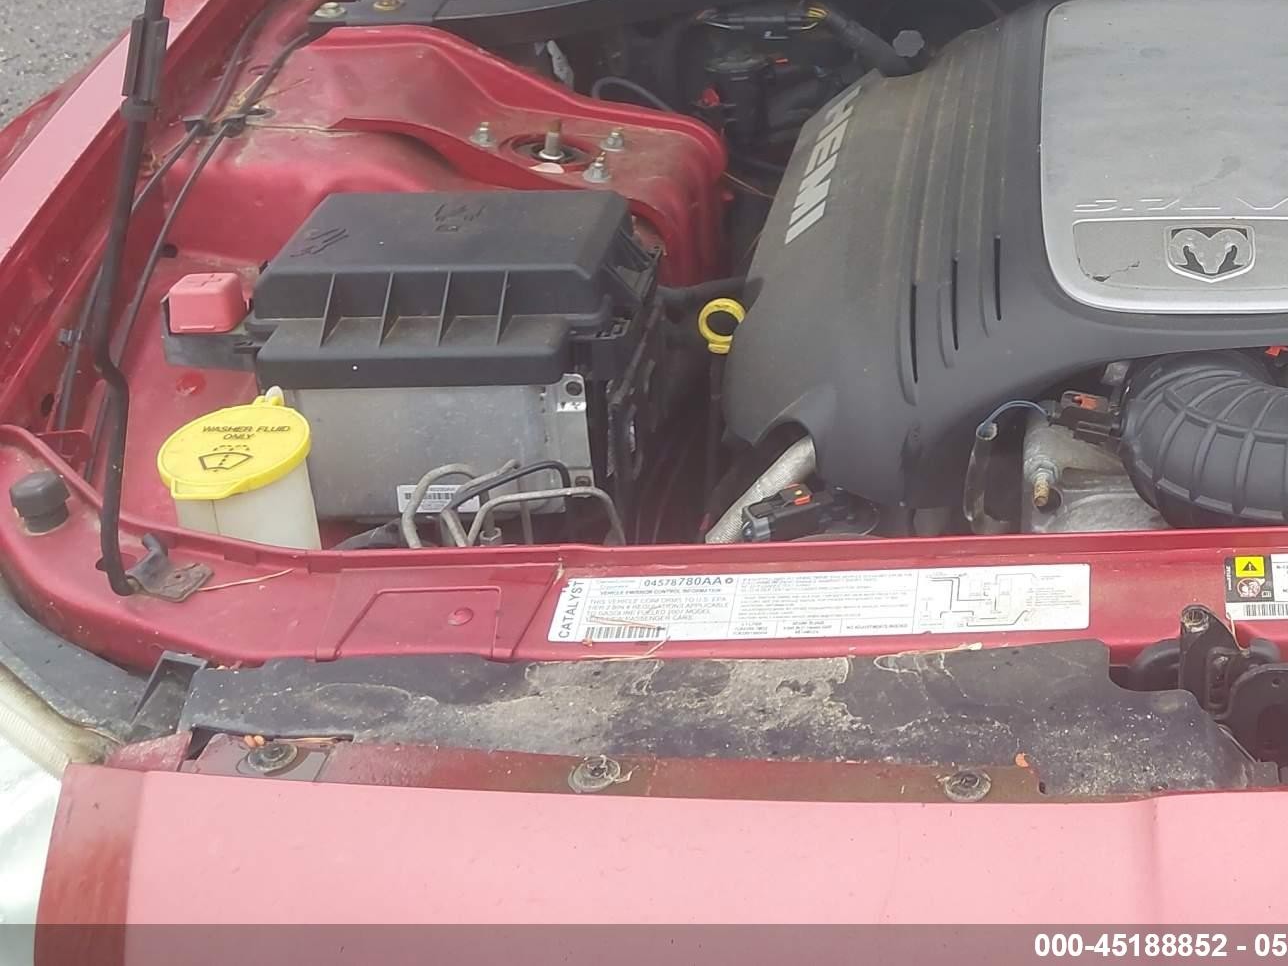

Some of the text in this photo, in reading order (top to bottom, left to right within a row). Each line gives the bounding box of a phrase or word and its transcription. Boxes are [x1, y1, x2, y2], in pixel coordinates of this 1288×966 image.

[784, 85, 862, 245] HEMI
[203, 425, 252, 433] WASHER
[644, 577, 721, 586] 04578780AA
[559, 581, 584, 638] CATALYST
